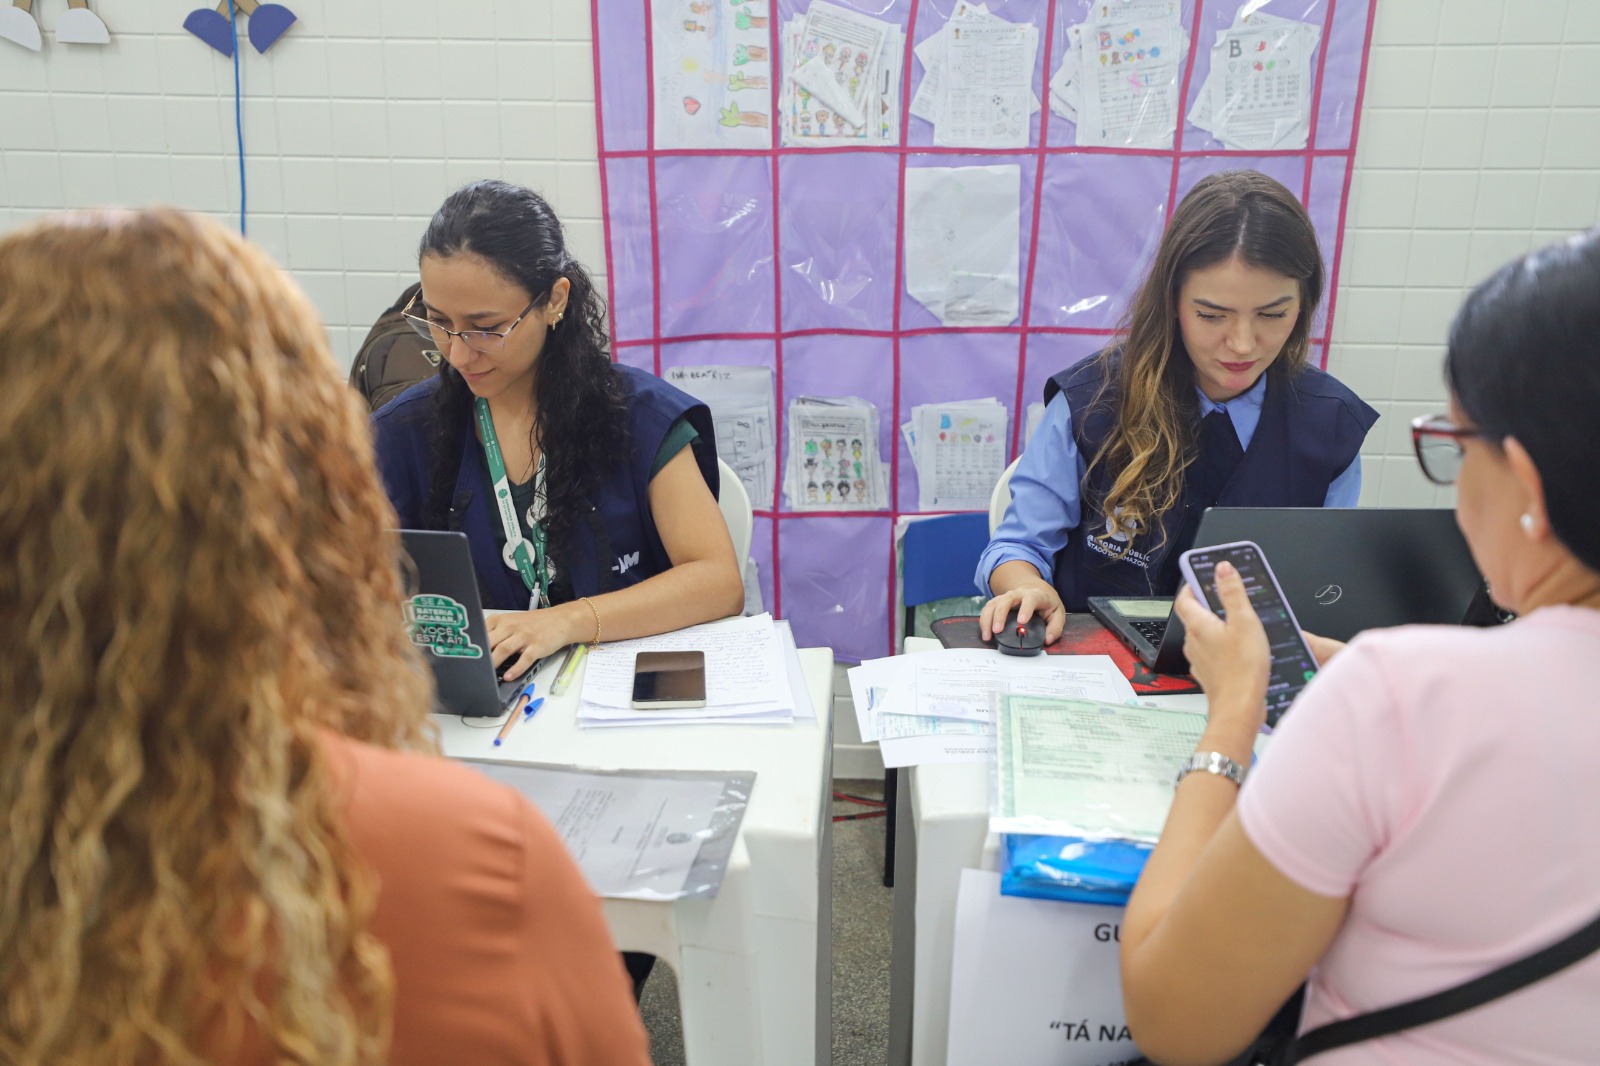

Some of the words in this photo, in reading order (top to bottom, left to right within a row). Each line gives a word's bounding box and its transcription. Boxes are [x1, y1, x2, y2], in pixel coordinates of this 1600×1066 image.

[1229, 40, 1242, 58] B
[421, 597, 434, 606] SE
[437, 598, 445, 606] A
[416, 607, 454, 616] BATERIA
[420, 626, 453, 636] VOCÊ
[447, 634, 463, 644] AÍ?
[1098, 1024, 1132, 1042] NA
